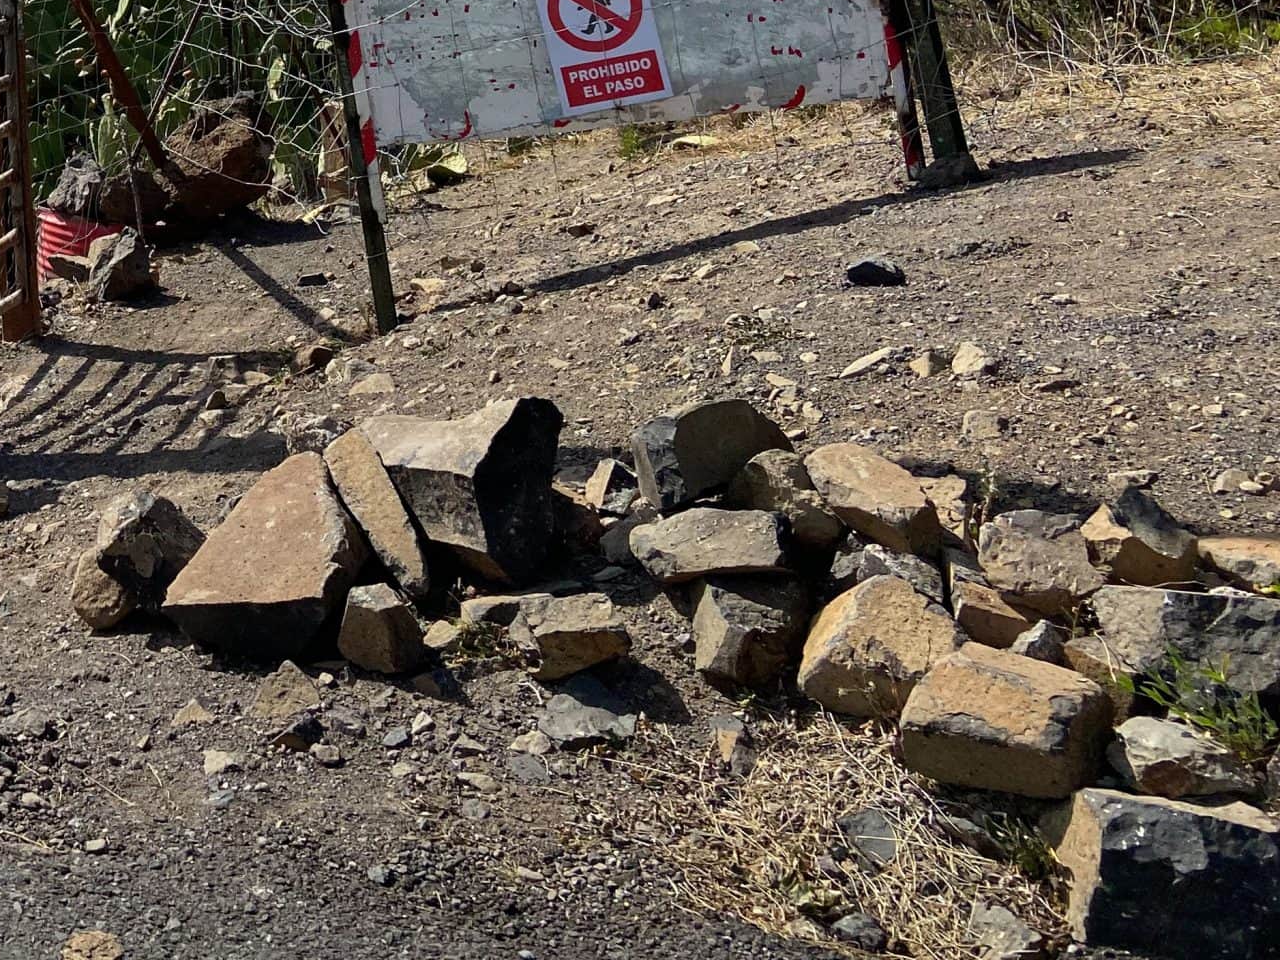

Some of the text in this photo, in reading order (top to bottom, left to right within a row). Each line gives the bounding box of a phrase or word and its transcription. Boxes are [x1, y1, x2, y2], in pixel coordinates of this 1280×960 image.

[568, 57, 652, 84] PROHIBIDO
[582, 76, 645, 99] EL PASO
